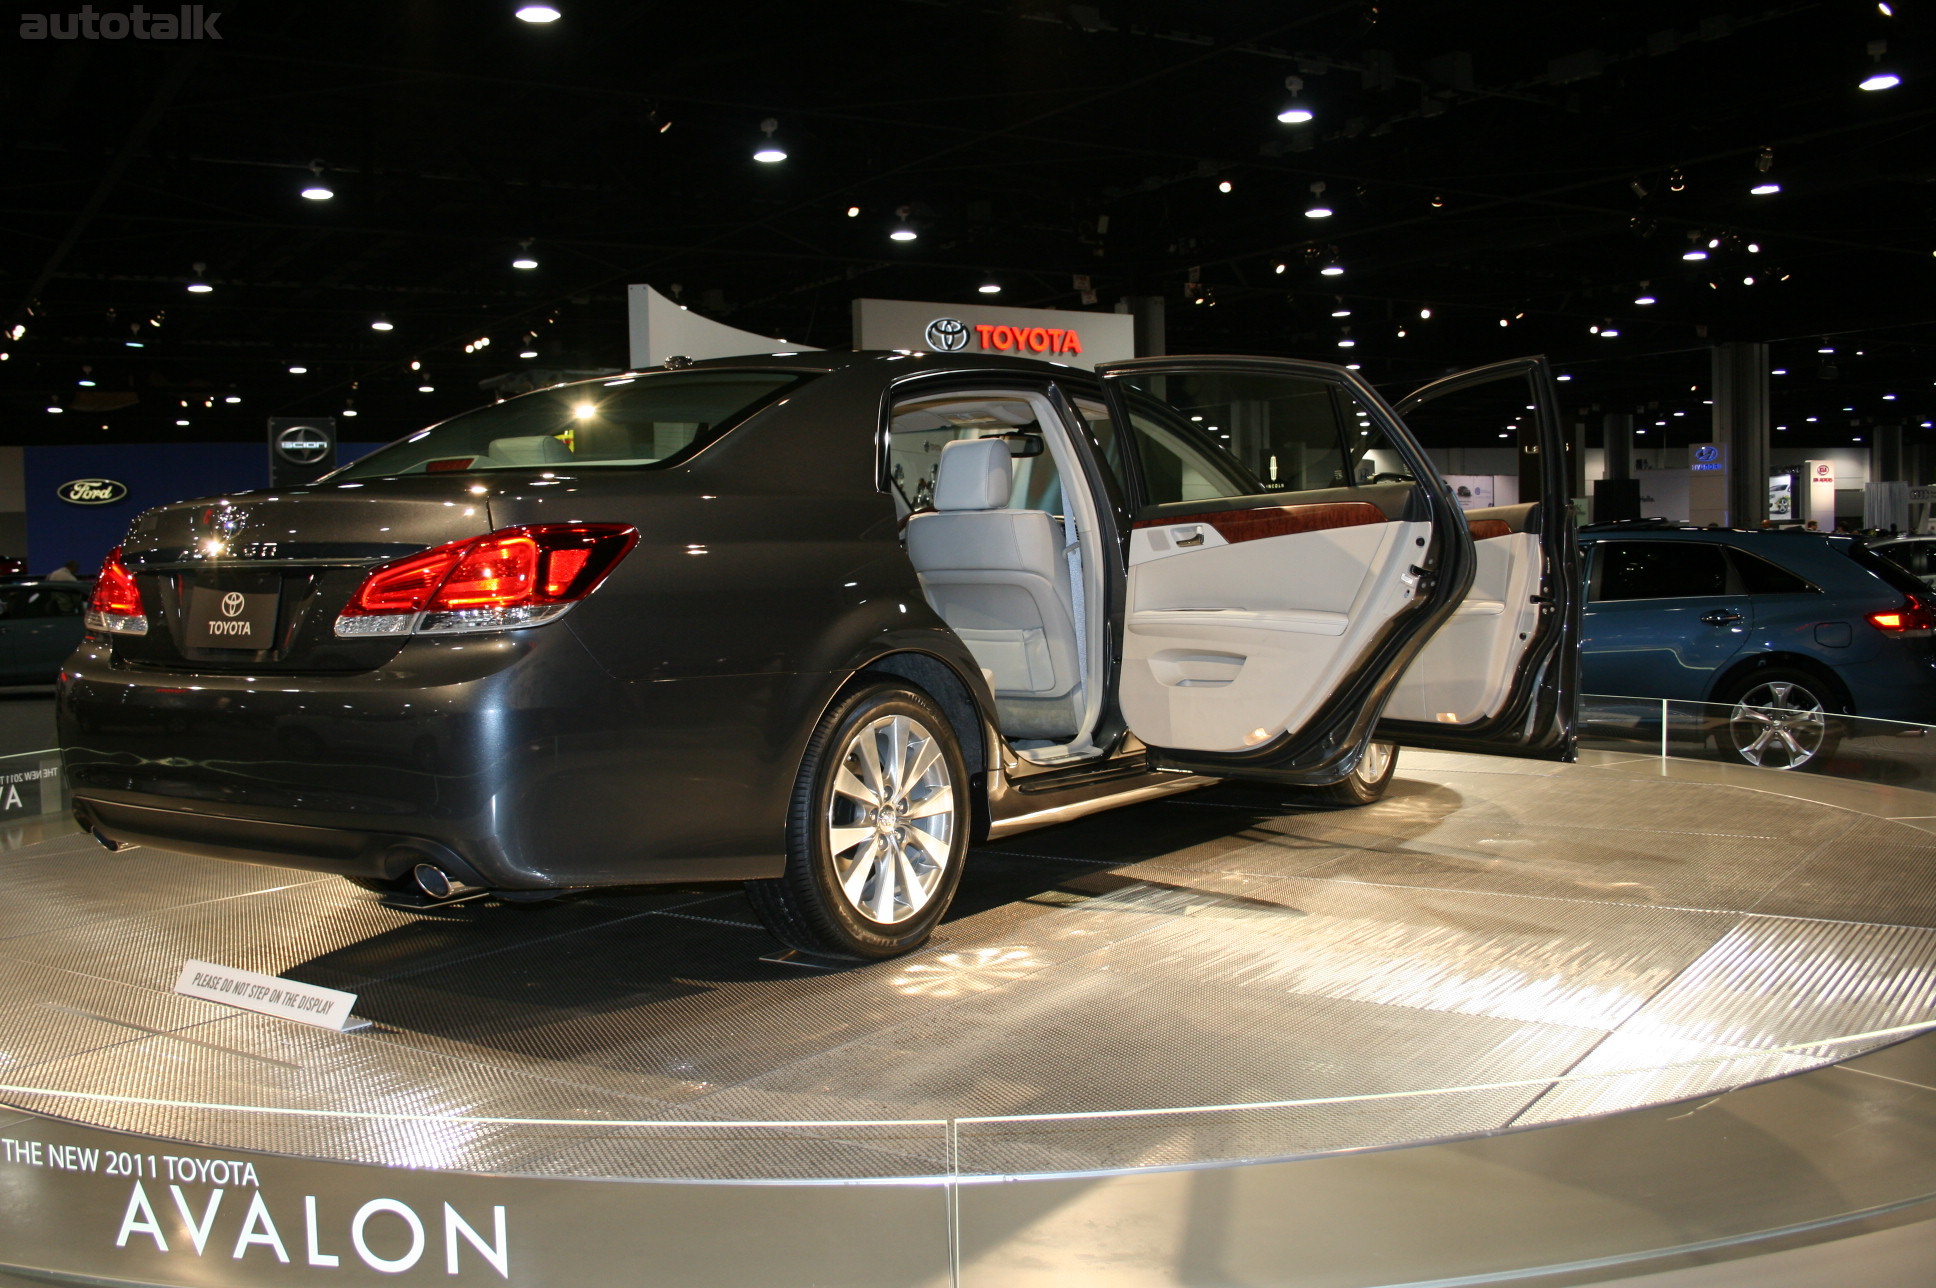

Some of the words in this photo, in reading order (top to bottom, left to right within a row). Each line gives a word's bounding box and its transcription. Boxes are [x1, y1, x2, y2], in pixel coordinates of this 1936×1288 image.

[975, 325, 1082, 354] TOYOTA
[70, 482, 113, 499] Ford
[208, 621, 251, 636] TOYOTA
[192, 972, 222, 990] PLEASE
[220, 978, 234, 993] DO
[232, 981, 251, 997] NOT
[250, 985, 271, 999] STEP
[269, 989, 283, 1004] ON
[281, 991, 298, 1008] THE
[299, 995, 335, 1016] DISPLAY
[2, 1138, 43, 1166] THE
[49, 1144, 99, 1172] NEW
[105, 1151, 156, 1178] 2011
[163, 1155, 260, 1187] TOYOTA
[116, 1180, 509, 1279] AVALON
